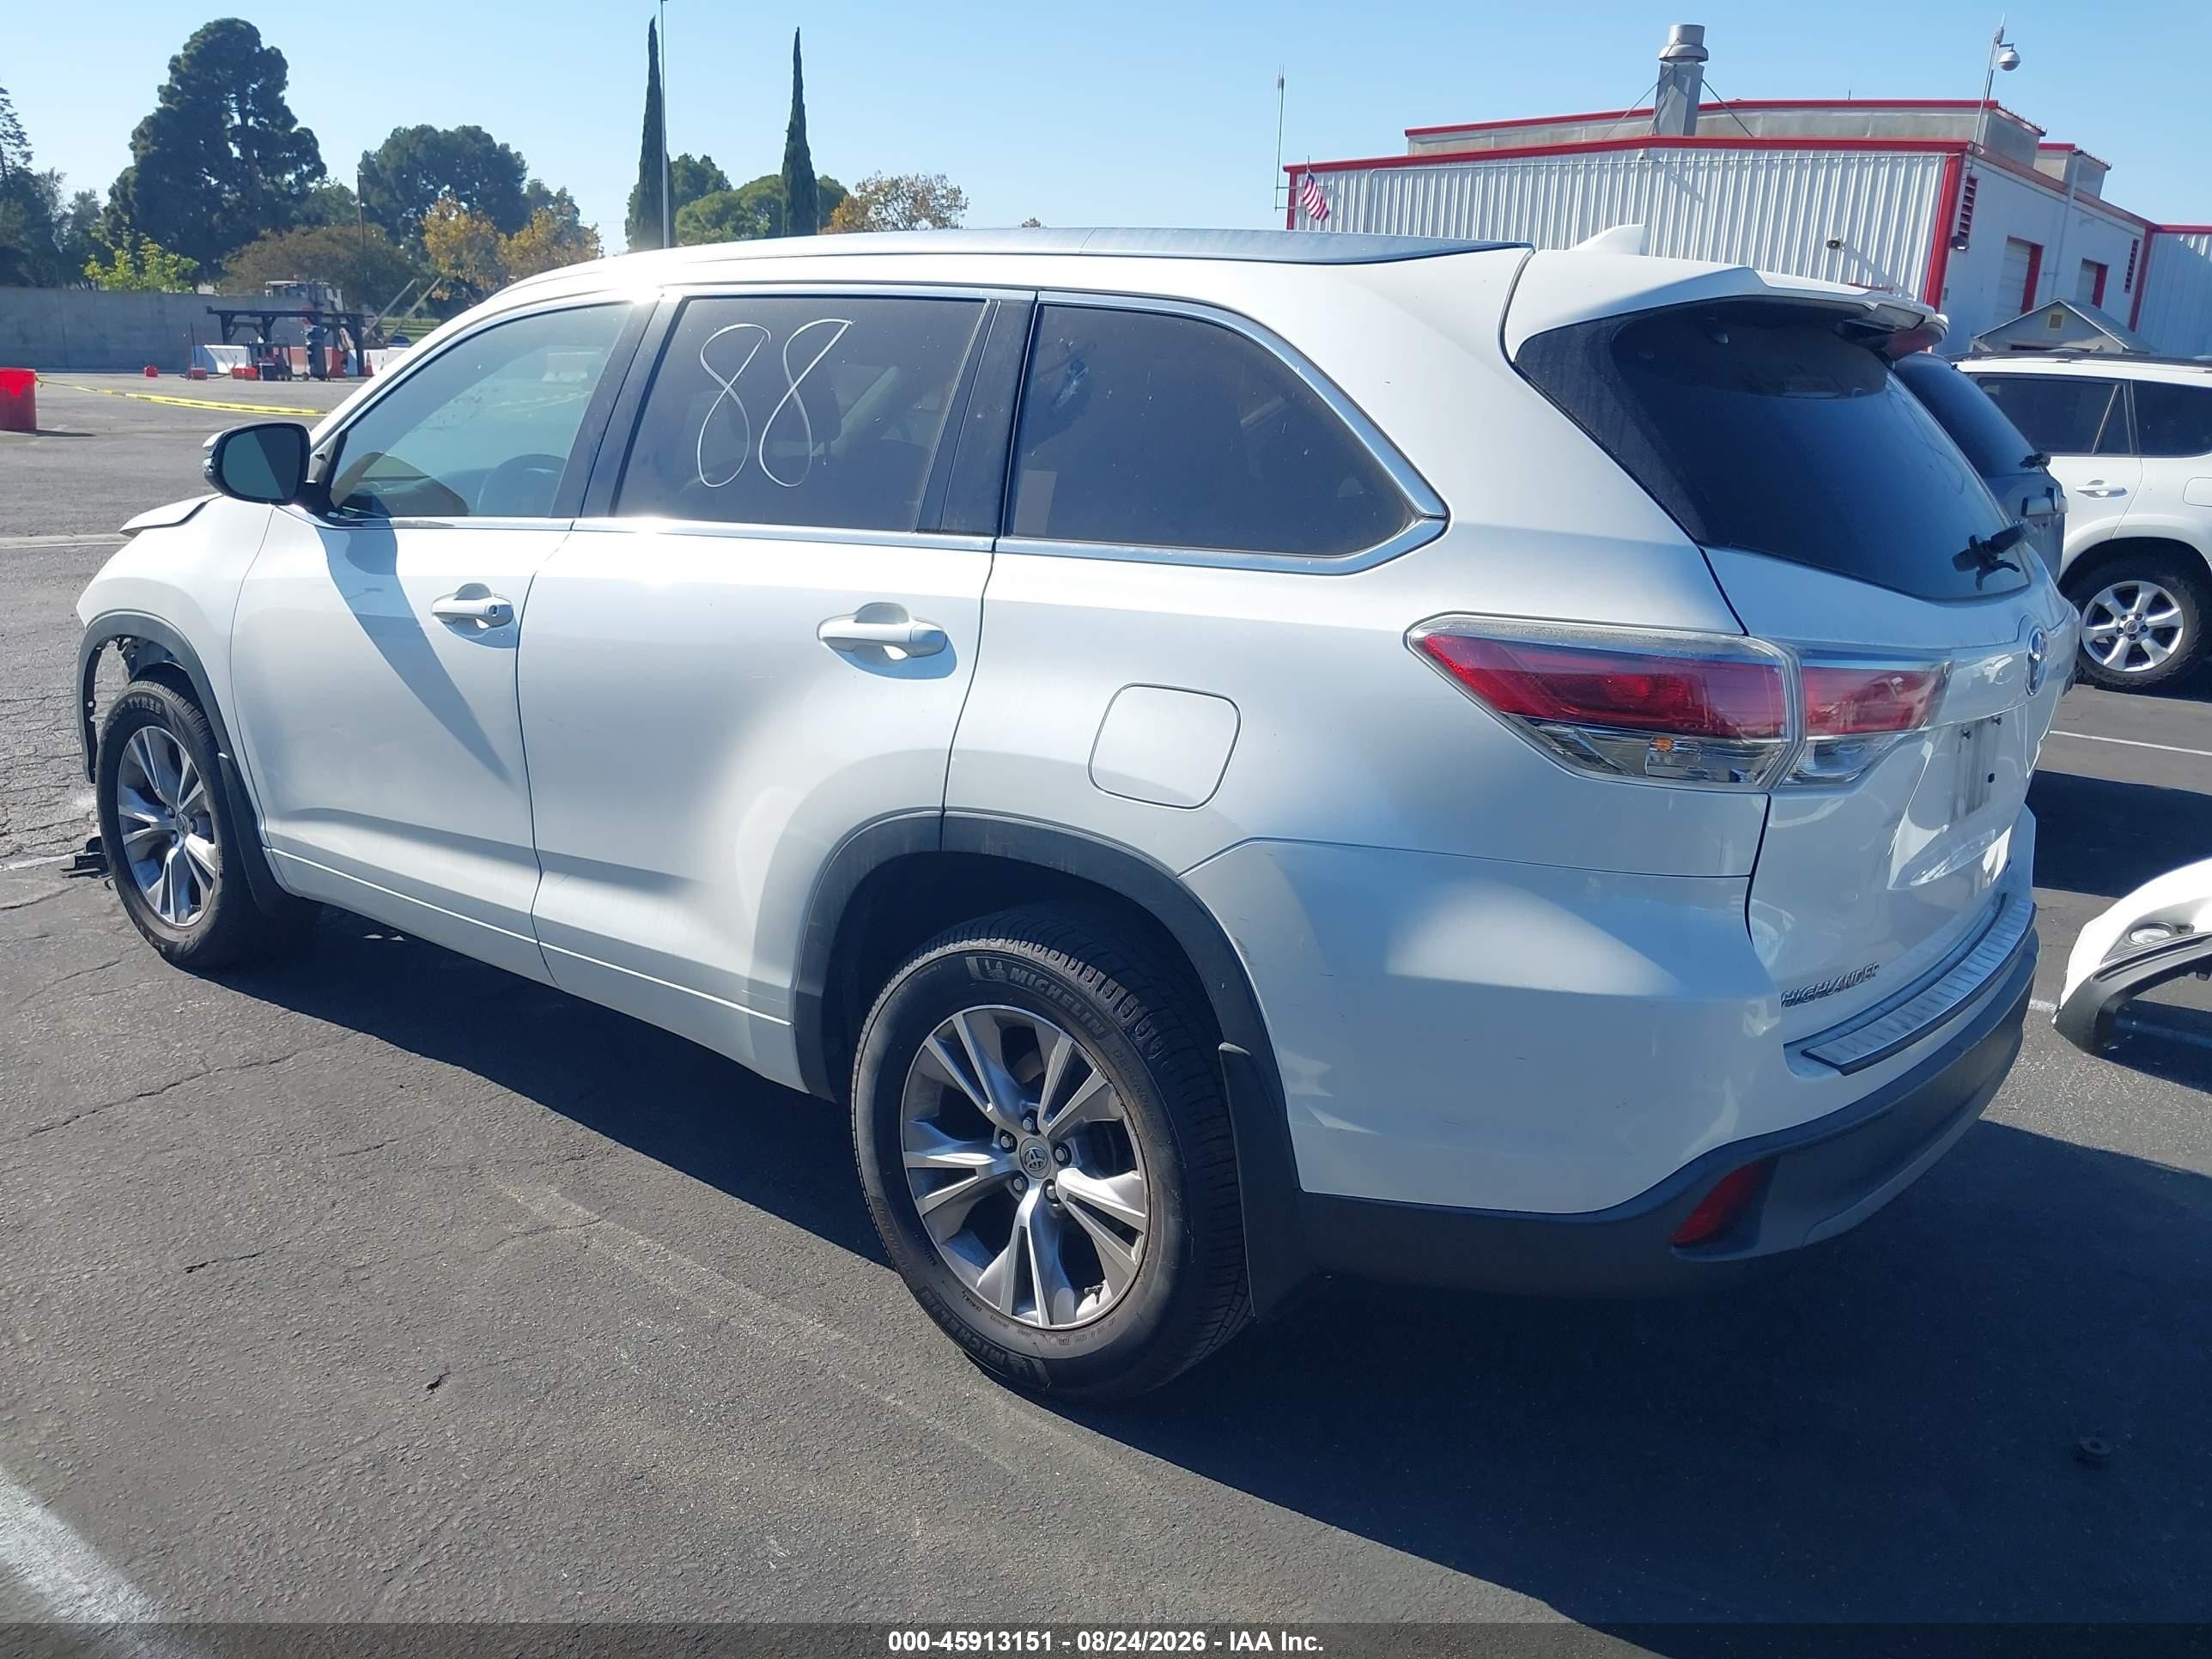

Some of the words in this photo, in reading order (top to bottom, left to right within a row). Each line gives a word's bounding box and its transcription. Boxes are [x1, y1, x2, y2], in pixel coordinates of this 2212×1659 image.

[697, 318, 856, 488] 88
[1009, 966, 1108, 1037] MICHELIN
[1780, 961, 1880, 1009] HIGHLANDER
